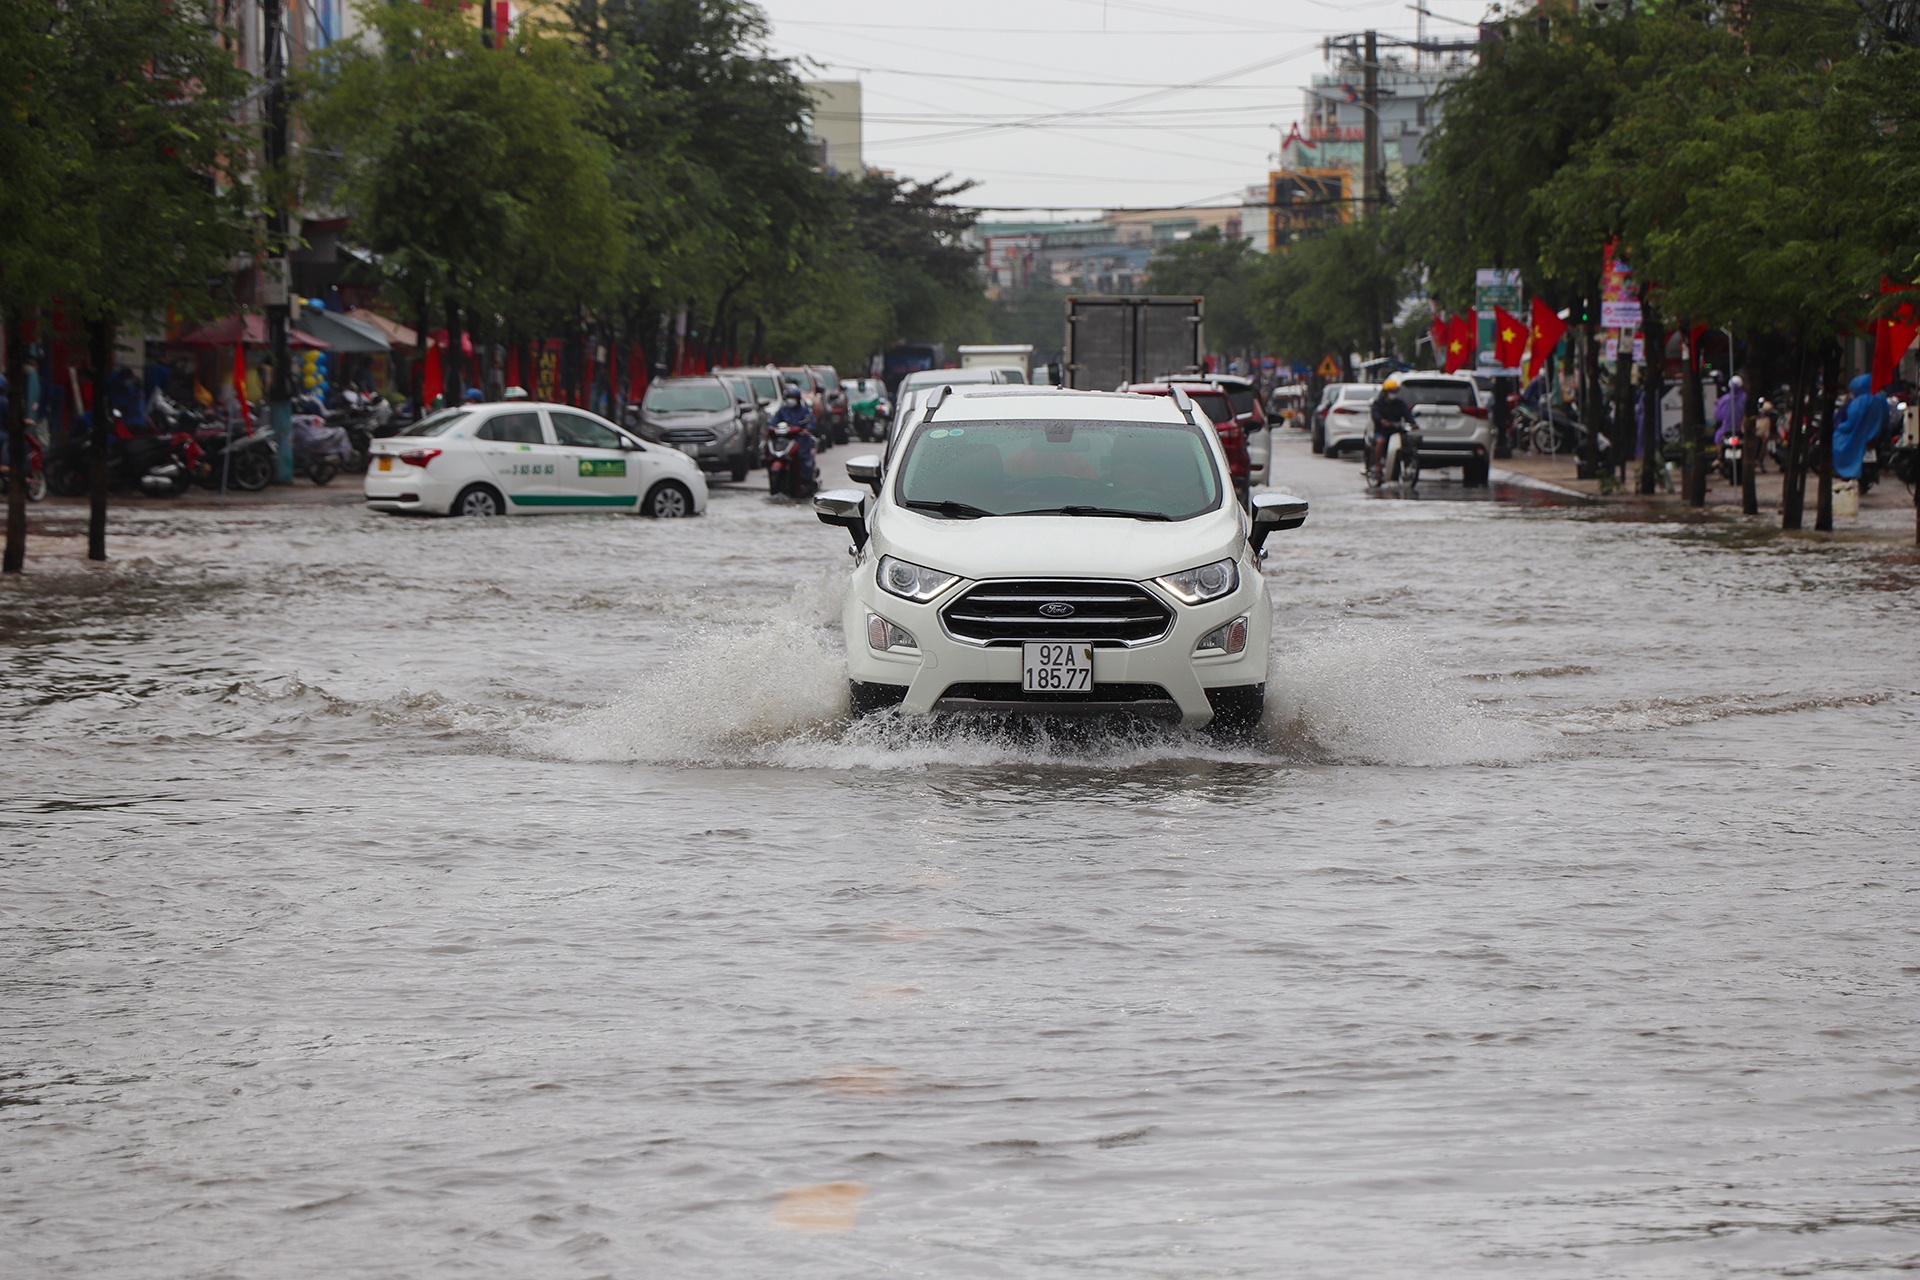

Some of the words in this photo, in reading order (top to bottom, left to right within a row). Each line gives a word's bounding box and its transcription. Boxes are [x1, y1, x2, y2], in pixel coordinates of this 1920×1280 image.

[1047, 604, 1067, 614] Ford
[1040, 645, 1075, 667] 92A
[1026, 667, 1090, 690] 185.77
